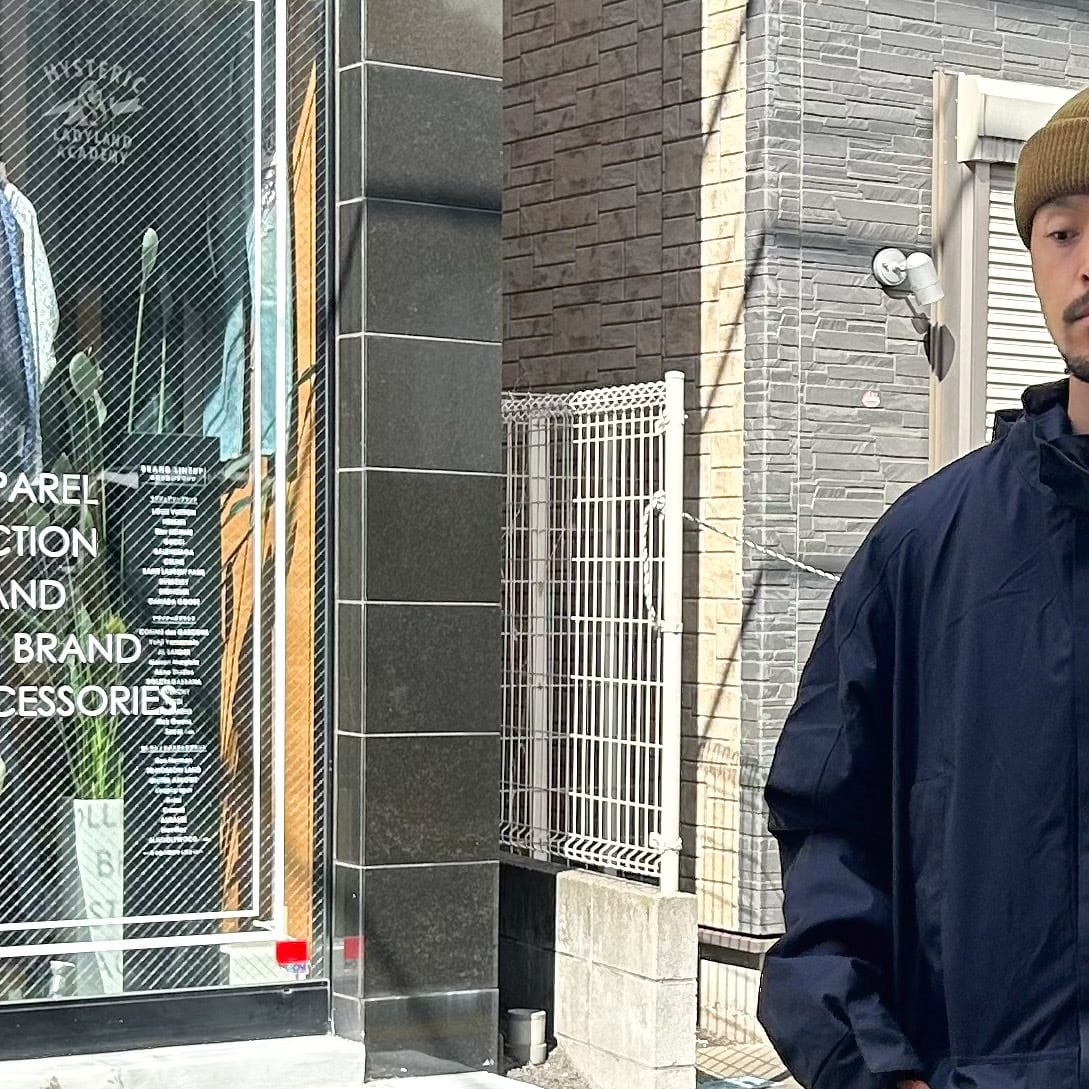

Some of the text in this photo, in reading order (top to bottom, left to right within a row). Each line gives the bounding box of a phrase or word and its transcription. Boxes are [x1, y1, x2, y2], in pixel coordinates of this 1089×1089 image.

[44, 59, 147, 94] HYSTERIC
[56, 144, 128, 164] ACADEMY
[14, 632, 142, 664] BRAND
